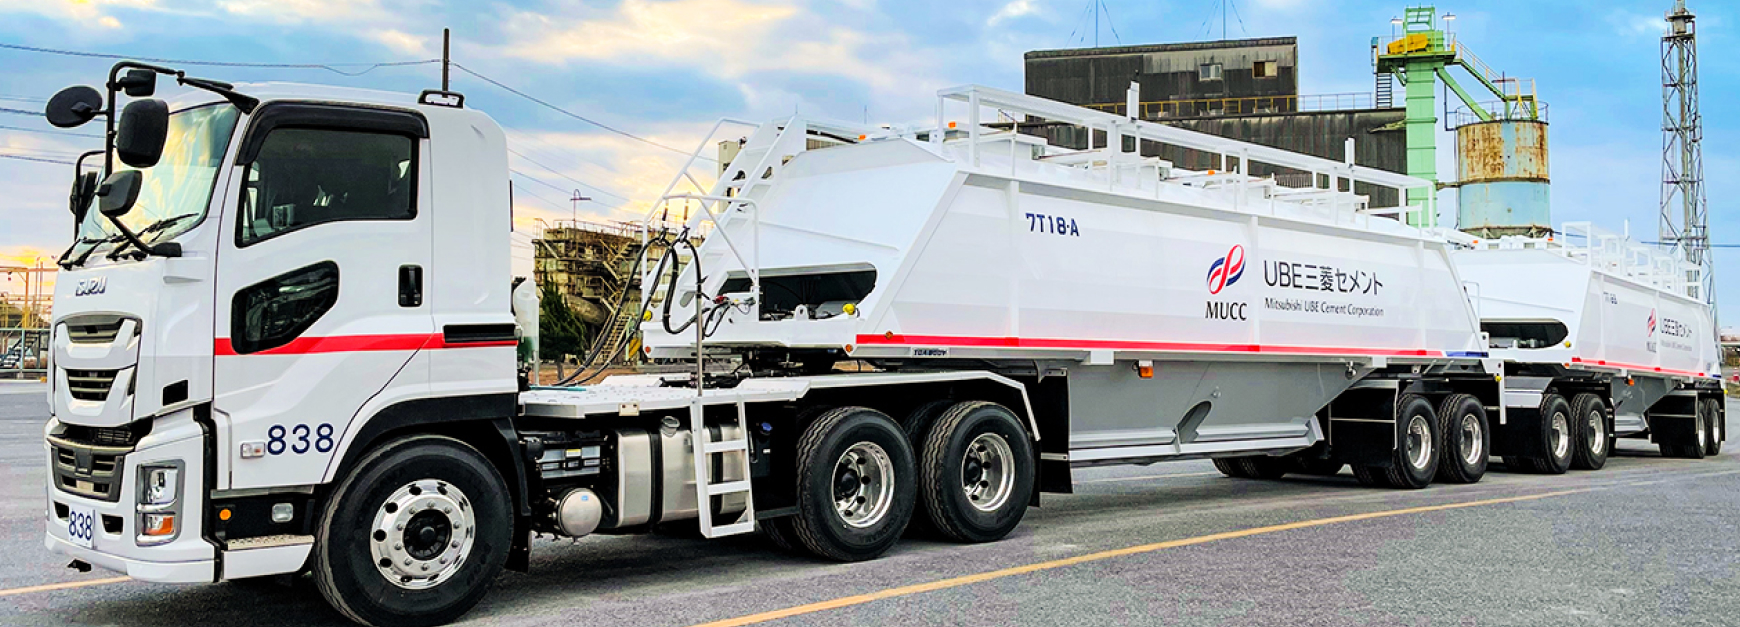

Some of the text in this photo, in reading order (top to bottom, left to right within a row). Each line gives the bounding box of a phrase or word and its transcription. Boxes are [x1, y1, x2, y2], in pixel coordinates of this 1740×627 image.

[1264, 259, 1383, 296] UBE三菱セメント
[1205, 301, 1248, 322] MUCC
[1264, 297, 1385, 318] Mitsubishi UBE Cement Corporation
[267, 423, 334, 455] 838
[69, 510, 93, 541] 838
